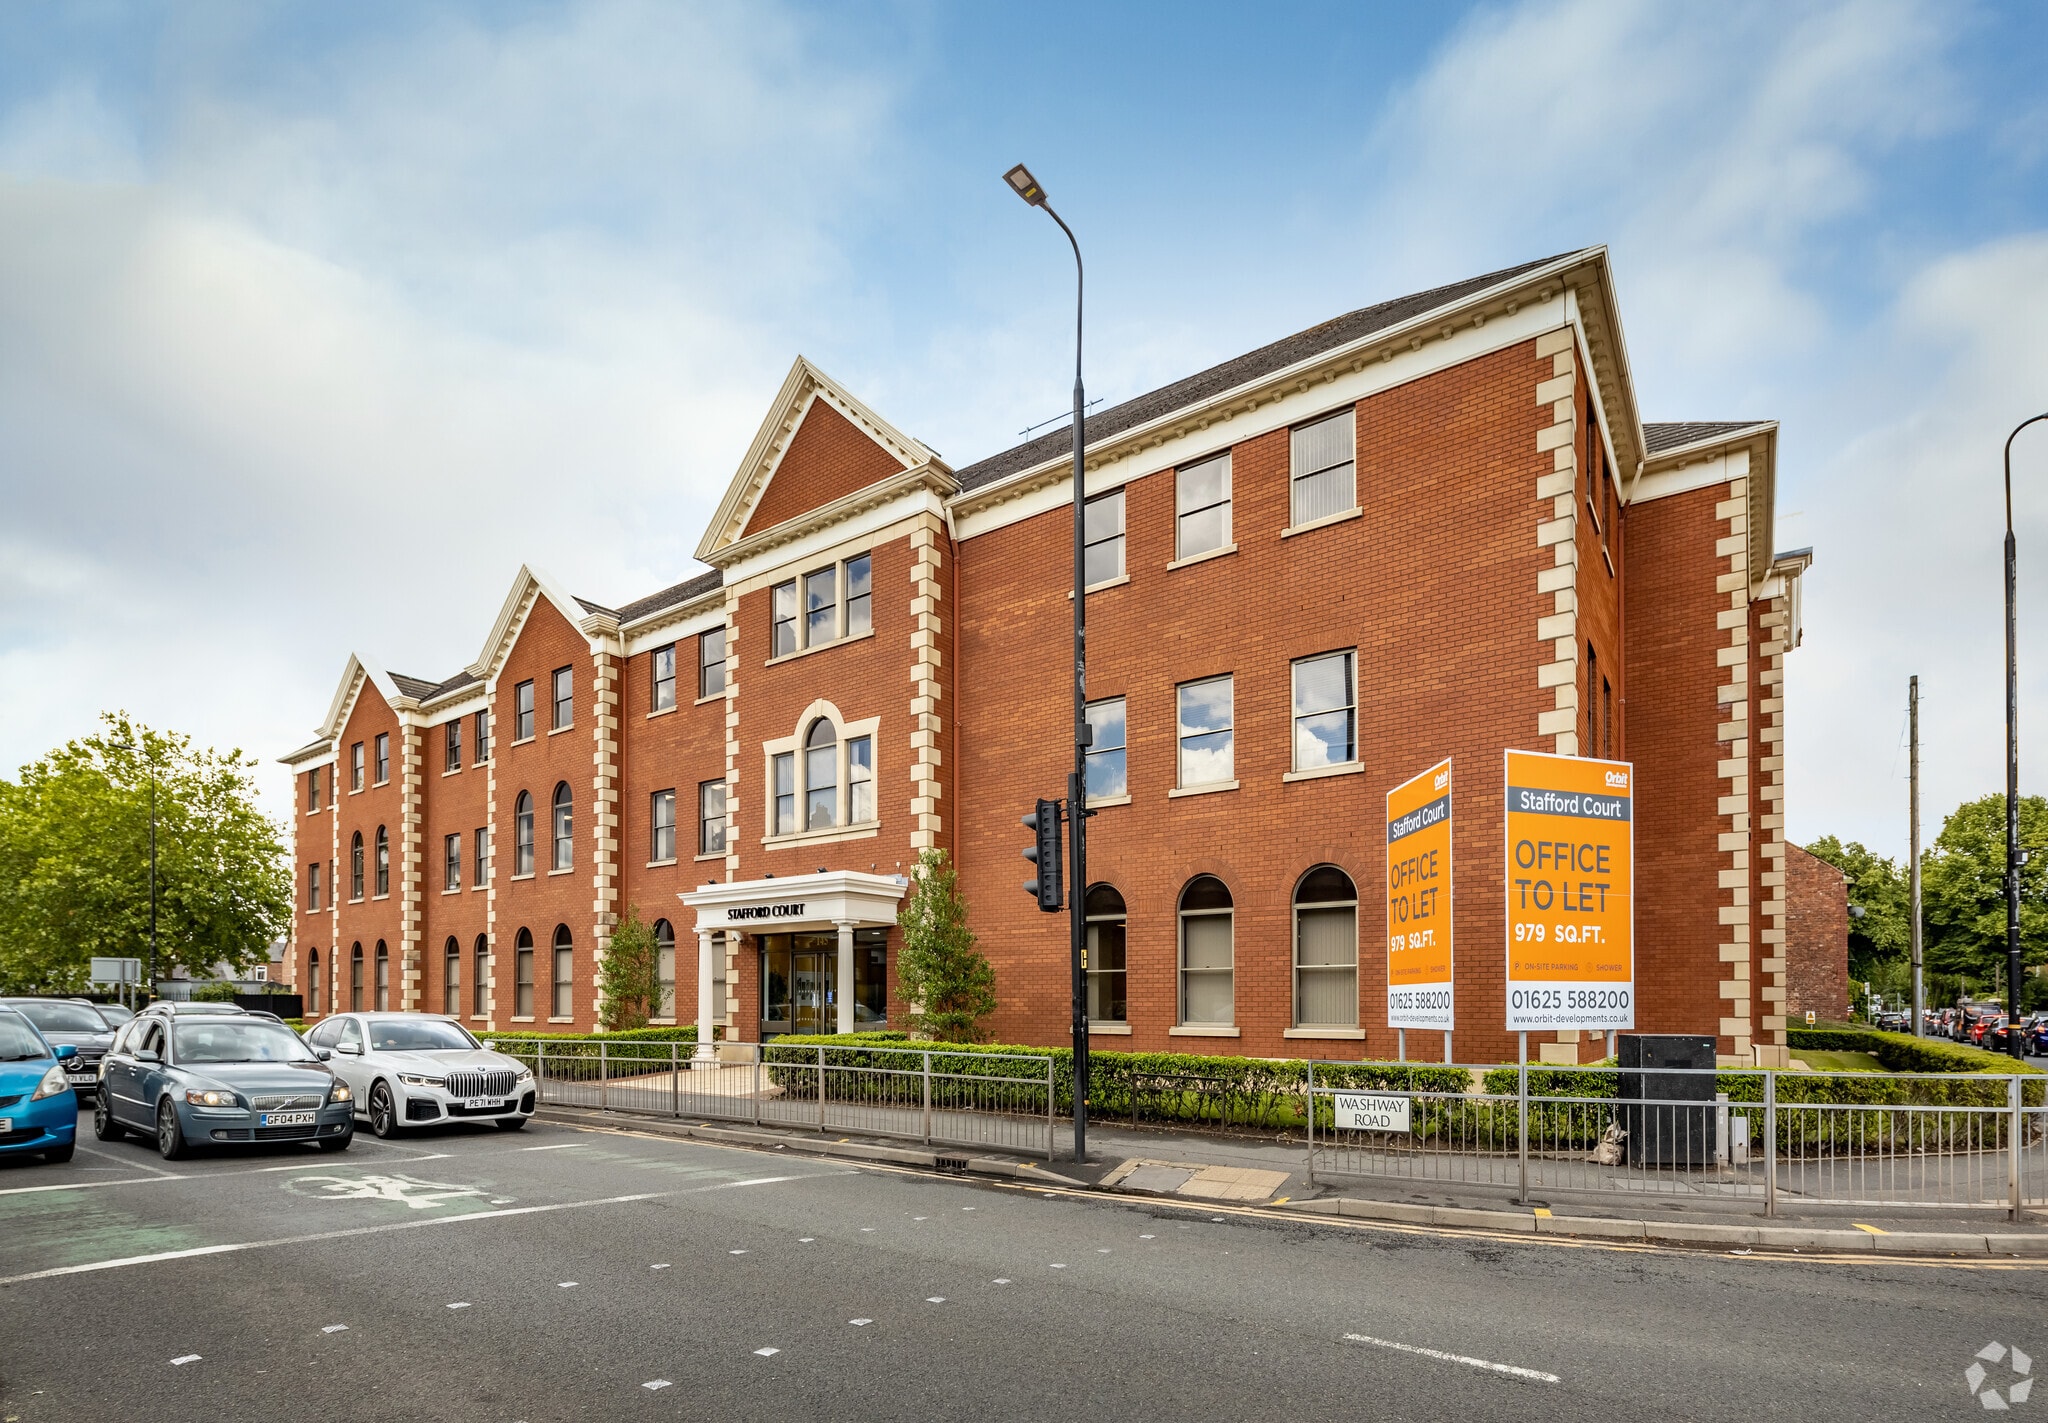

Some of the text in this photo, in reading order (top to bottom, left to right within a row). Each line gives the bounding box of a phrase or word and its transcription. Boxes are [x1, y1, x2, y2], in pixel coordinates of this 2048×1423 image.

[1605, 770, 1628, 785] Orbit
[1520, 790, 1621, 817] Stafford Court
[1392, 801, 1445, 839] Stafford Court
[1515, 839, 1610, 873] OFFICE
[1391, 849, 1438, 890] OFFICE
[1515, 879, 1610, 912] TO LET
[728, 903, 805, 920] STAFFORD COURT
[1391, 887, 1438, 924] TO LET
[1391, 929, 1436, 952] 979 SQ.FT.
[1515, 923, 1606, 944] 979 SQ.FT.
[1551, 963, 1579, 971] PARKING
[1390, 991, 1451, 1010] 01625 588200
[1512, 990, 1629, 1009] 01625 588200
[1513, 1013, 1628, 1024] www.orbit-developments.co.uk
[1339, 1097, 1404, 1112] WASHWAY
[267, 1114, 314, 1125] GF04 PXH
[1354, 1113, 1391, 1127] ROAD
